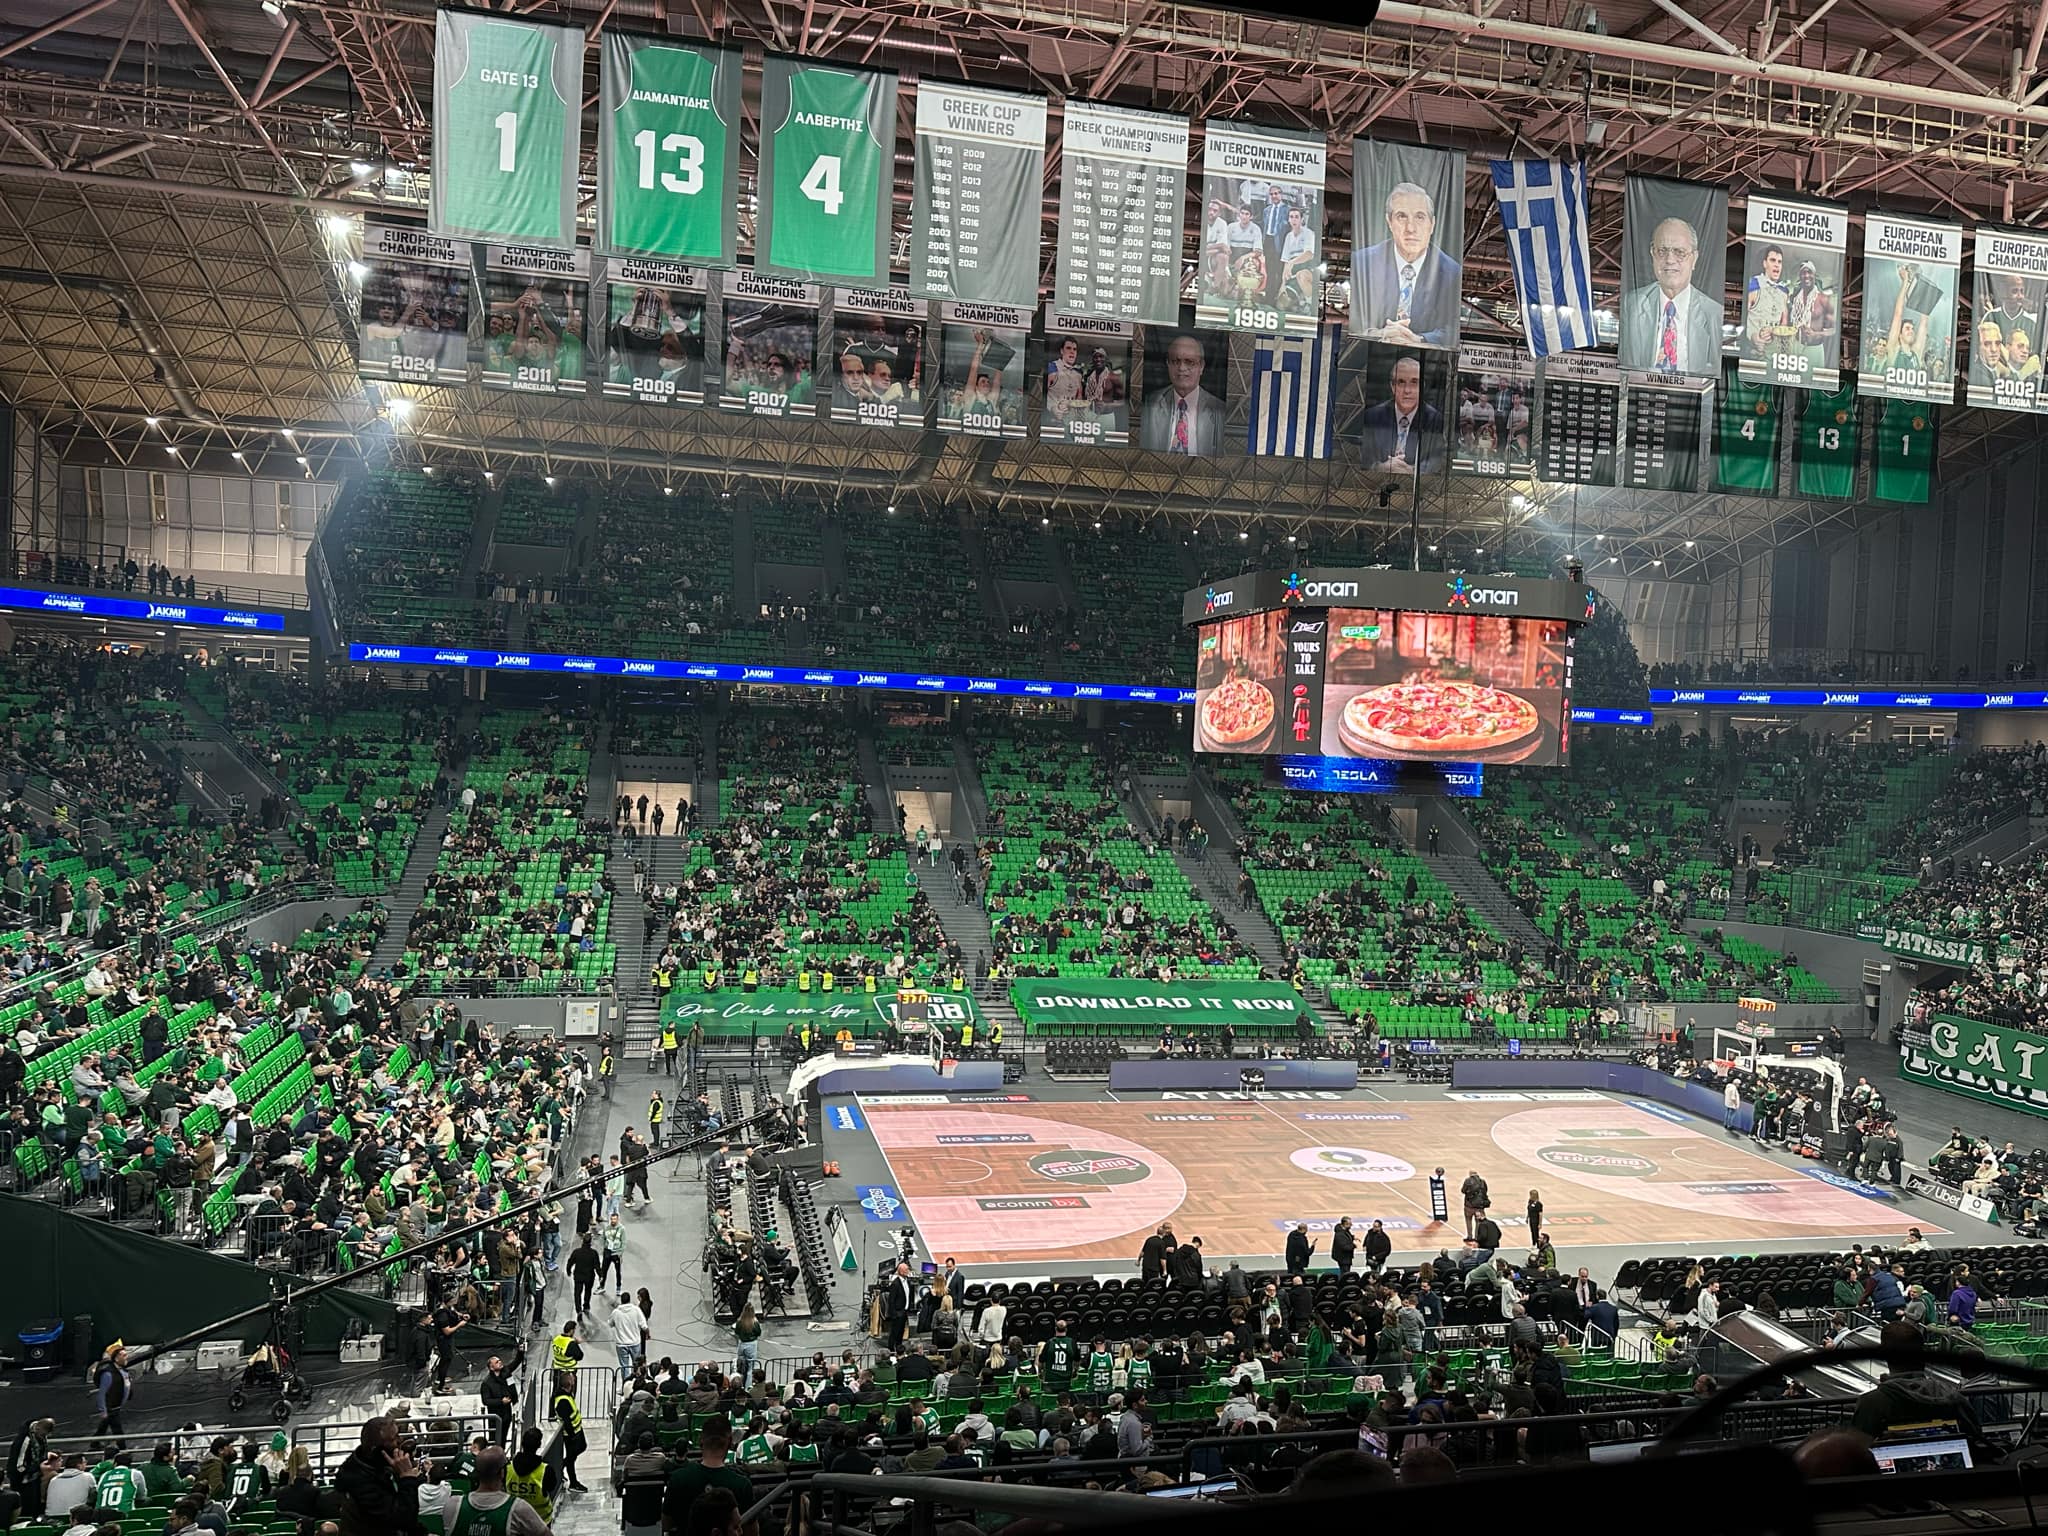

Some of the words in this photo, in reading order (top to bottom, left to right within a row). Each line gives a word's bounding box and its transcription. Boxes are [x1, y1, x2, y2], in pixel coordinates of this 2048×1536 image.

[480, 68, 518, 87] GATE
[523, 75, 539, 89] 13
[632, 89, 710, 110] ΔΙΑΜΑΝΤΙΔΗΣ
[943, 99, 989, 117] GREEK
[993, 105, 1021, 121] CUP
[795, 111, 864, 133] ΑΛΒΕΡΤΗΣ
[947, 115, 1015, 136] WINNERS
[1067, 120, 1102, 134] GREEK
[1105, 125, 1186, 144] CHAMPIONSHIP
[495, 112, 517, 172] 1
[1101, 136, 1151, 153] WINNERS
[1210, 140, 1320, 164] INTERCONTINENTAL
[634, 130, 704, 195] 13
[1224, 155, 1247, 167] CUP
[1250, 158, 1304, 175] WINNERS
[800, 155, 844, 215] 4
[1766, 207, 1829, 229] EUROPEAN
[384, 230, 451, 249] EUROPEAN
[1761, 221, 1832, 242] CHAMPIONS
[1884, 226, 1943, 245] EUROPEAN
[379, 241, 455, 261] CHAMPIONS
[1879, 239, 1947, 259] CHAMPIONS
[501, 254, 575, 273] CHAMPIONS
[621, 267, 693, 286] CHAMPIONS
[737, 282, 806, 300] CHAMPIONS
[848, 295, 914, 313] CHAMPIONS
[954, 306, 1019, 325] CHAMPIONS
[1058, 316, 1121, 333] CHAMPIONS
[1234, 308, 1279, 330] 1996
[391, 355, 435, 372] 2024
[1471, 358, 1486, 366] CUP
[1488, 360, 1522, 370] WINNERS
[1568, 366, 1599, 376] WINNERS
[1772, 353, 1808, 372] 1996
[518, 366, 551, 383] 2011
[1646, 374, 1685, 385] WINNERS
[1777, 373, 1801, 384] PARIS
[1886, 367, 1927, 387] 2000
[633, 377, 675, 394] 2009
[1995, 379, 2035, 397] 2002
[748, 390, 788, 408] 2007
[1997, 396, 2031, 407] BOLOGNA
[858, 402, 897, 418] 2002
[963, 413, 1001, 428] 2000
[1069, 420, 1101, 435] 1996
[1740, 419, 1755, 441] 4
[1818, 427, 1840, 450] 13
[1902, 434, 1910, 456] 1
[1477, 460, 1506, 474] 1996
[1293, 642, 1320, 653] YOURS
[1300, 653, 1311, 664] TO
[1295, 664, 1316, 675] TAKE
[1283, 767, 1317, 778] TESLA
[1333, 770, 1378, 781] TESLA
[1445, 774, 1474, 784] TESLA
[1883, 929, 1984, 964] PATISSIA
[676, 1003, 716, 1018] One
[722, 1002, 778, 1018] Club
[786, 1007, 813, 1017] one
[820, 1003, 861, 1019] App
[1035, 996, 1192, 1009] DOWNLOAD
[1199, 998, 1222, 1009] IT
[1231, 999, 1295, 1010] NOW
[1161, 1091, 1342, 1101] ATHENS
[1935, 1186, 1961, 1206] Uber
[1054, 1351, 1066, 1364] 10
[232, 1476, 249, 1495] 10
[509, 1482, 537, 1495] CSI
[101, 1487, 123, 1507] 10
